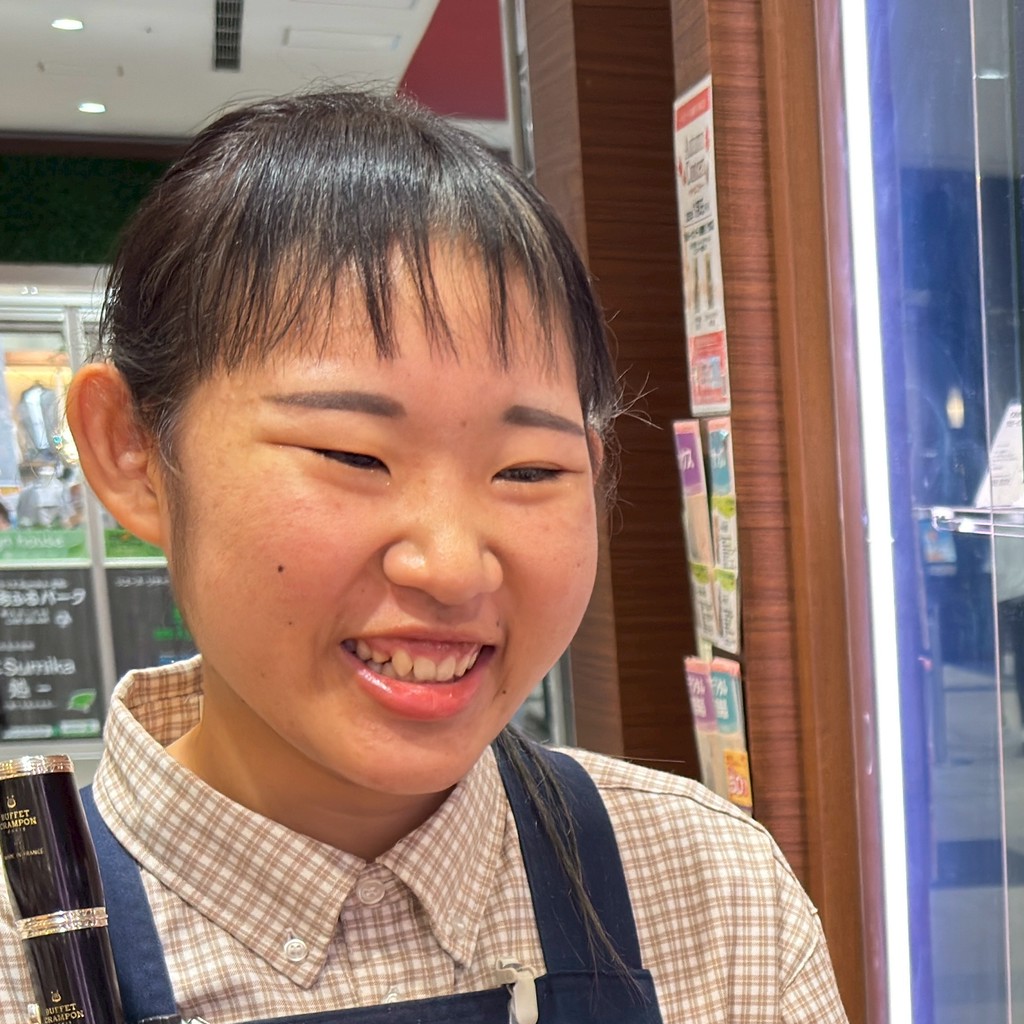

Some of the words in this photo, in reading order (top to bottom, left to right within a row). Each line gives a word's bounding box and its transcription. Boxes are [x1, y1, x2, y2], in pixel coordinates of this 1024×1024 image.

[1, 809, 30, 821] BUFFET
[45, 1002, 77, 1016] BUFFET
[44, 1009, 85, 1024] CRAMPON
